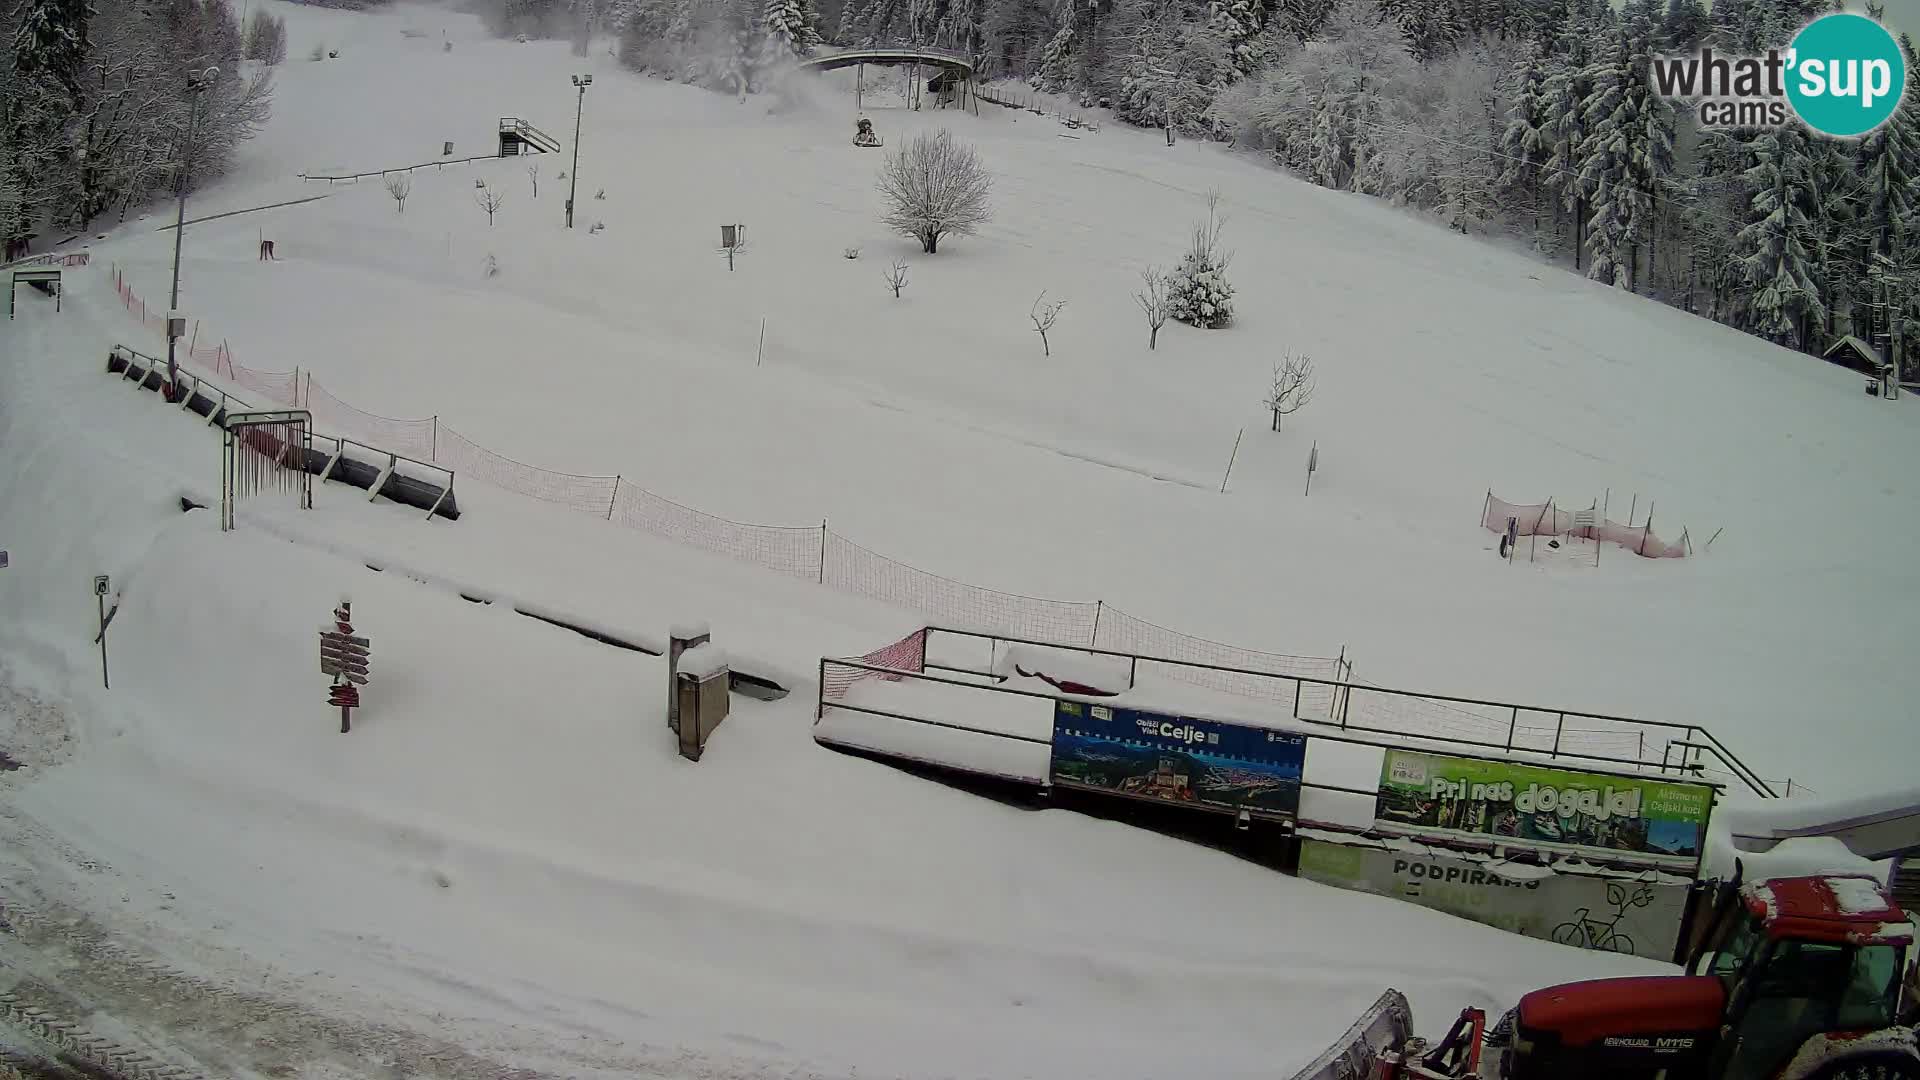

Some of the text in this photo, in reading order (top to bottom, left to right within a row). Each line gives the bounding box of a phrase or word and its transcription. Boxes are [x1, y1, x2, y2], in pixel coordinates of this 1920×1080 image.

[1142, 727, 1159, 736] Visit
[1160, 722, 1205, 744] Celje
[1431, 778, 1641, 820] Pri nas dogaja!
